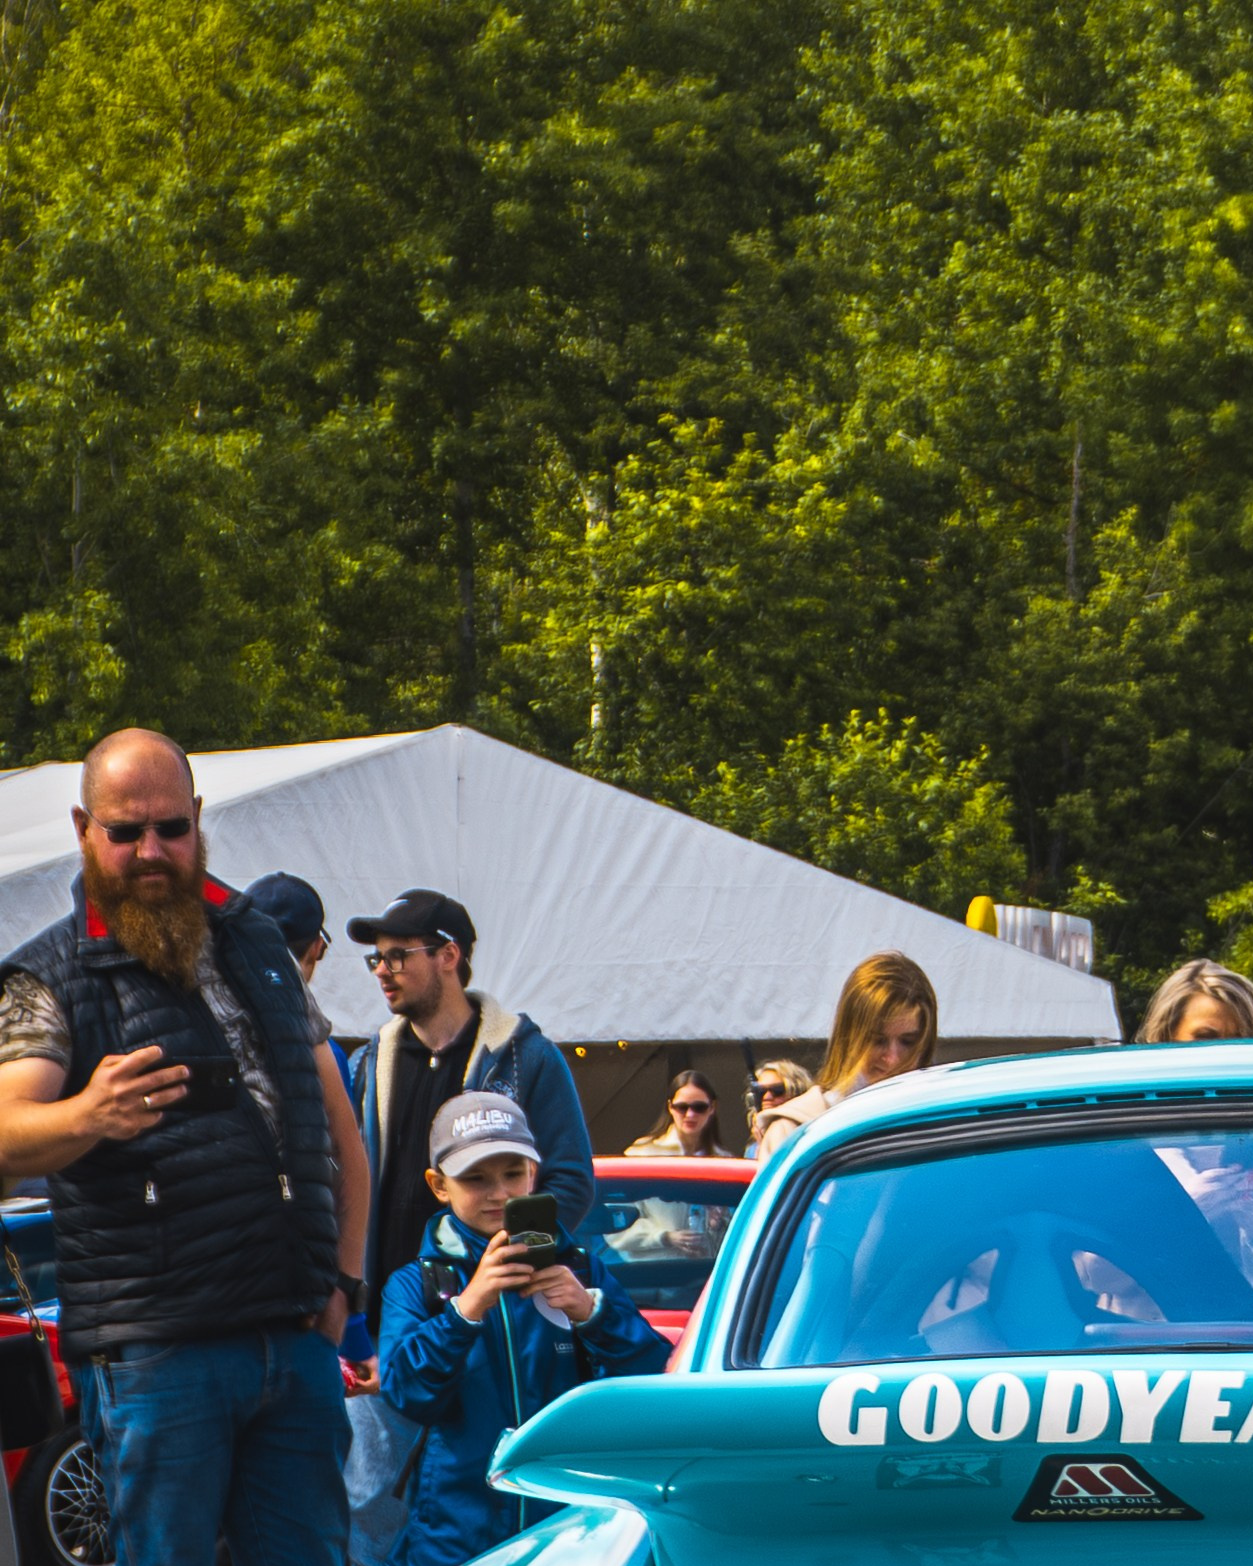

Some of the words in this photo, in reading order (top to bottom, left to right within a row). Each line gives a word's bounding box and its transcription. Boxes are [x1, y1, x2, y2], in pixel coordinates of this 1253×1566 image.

[452, 1109, 513, 1136] MALIBU
[1049, 1497, 1121, 1506] MILLERS
[1125, 1497, 1163, 1506] OILS
[1030, 1507, 1185, 1516] NANODRIVE
